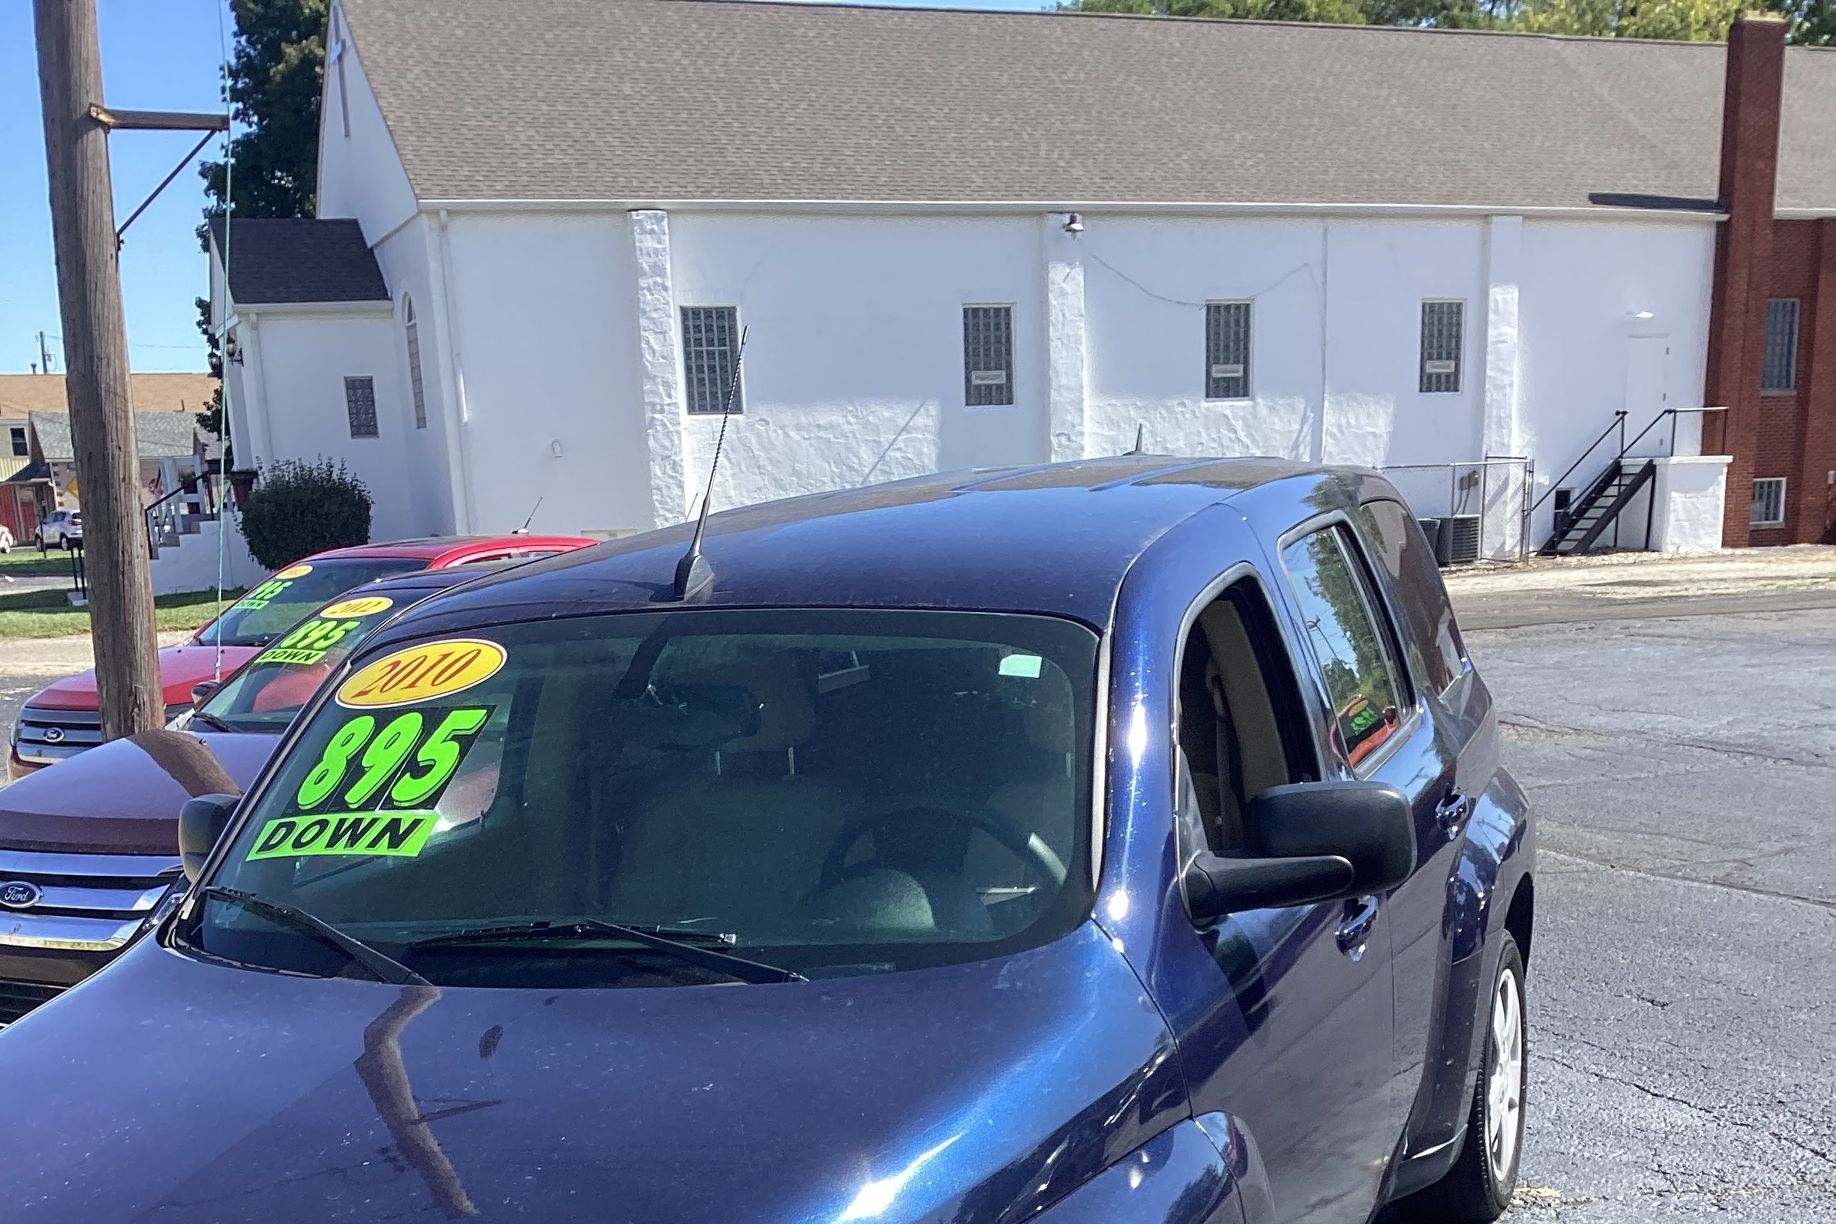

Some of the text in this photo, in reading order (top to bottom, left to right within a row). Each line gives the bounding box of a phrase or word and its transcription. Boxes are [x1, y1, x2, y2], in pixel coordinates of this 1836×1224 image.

[280, 620, 361, 650] 895
[259, 650, 321, 662] DOWN
[350, 648, 482, 699] 2010
[297, 709, 488, 809] 895
[256, 817, 425, 855] DOWN
[4, 886, 30, 902] Ford
